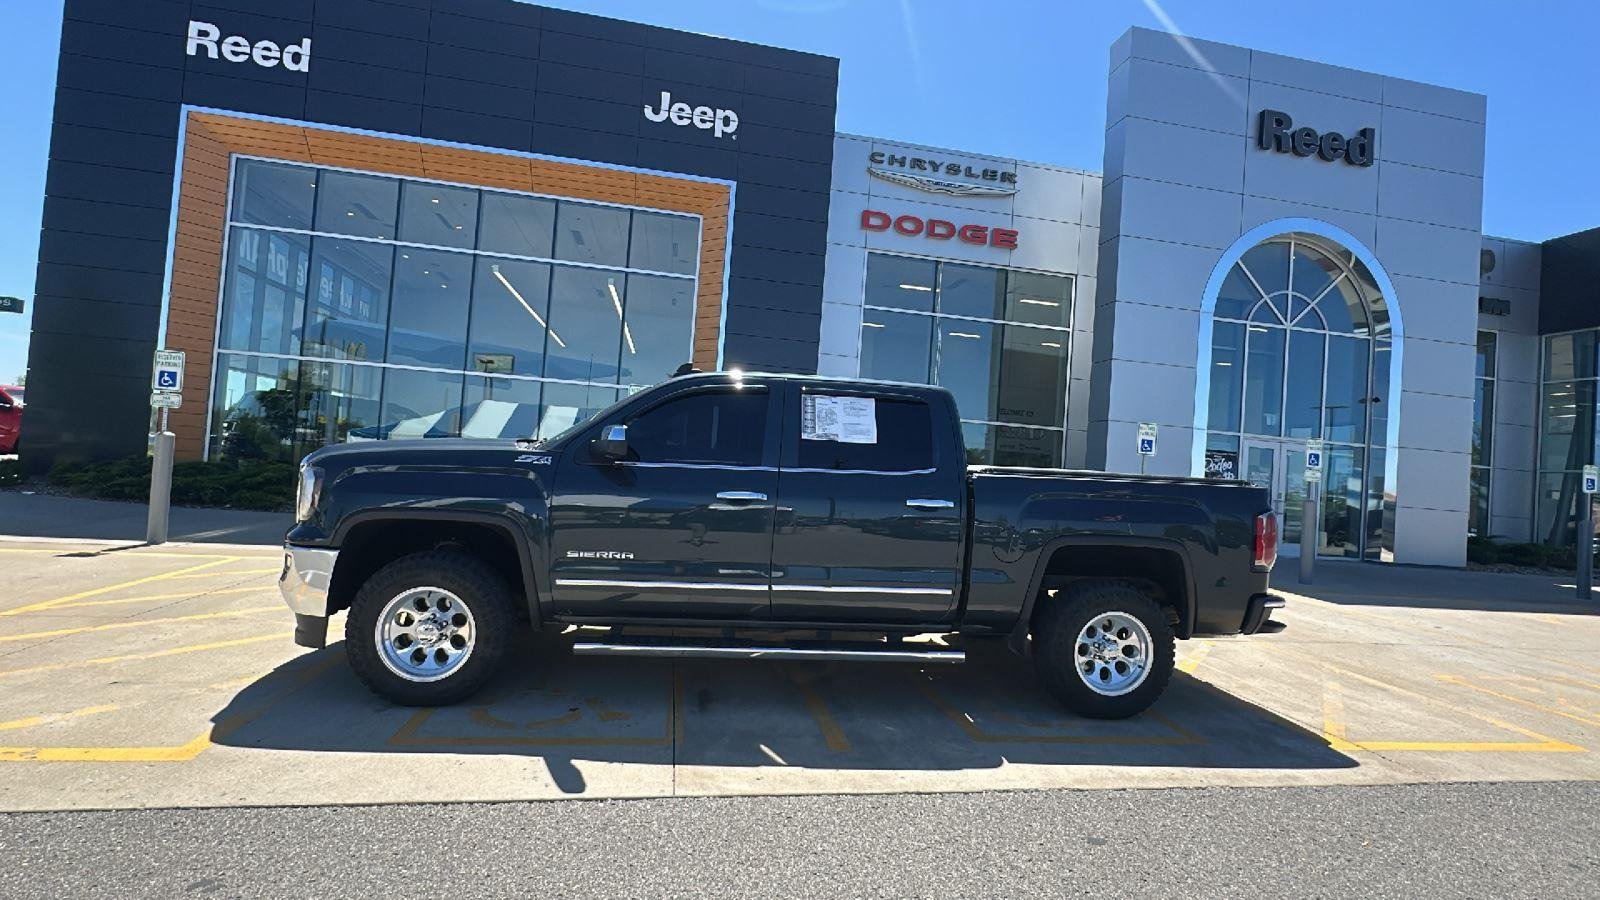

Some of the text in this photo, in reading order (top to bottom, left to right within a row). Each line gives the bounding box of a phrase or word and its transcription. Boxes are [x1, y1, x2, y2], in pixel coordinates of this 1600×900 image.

[186, 20, 312, 73] Reed
[643, 91, 739, 138] Jeep
[1258, 109, 1376, 168] Reed
[869, 151, 1018, 184] CHRYSLER
[861, 209, 1019, 250] DODGE
[565, 550, 635, 560] SIERRA
